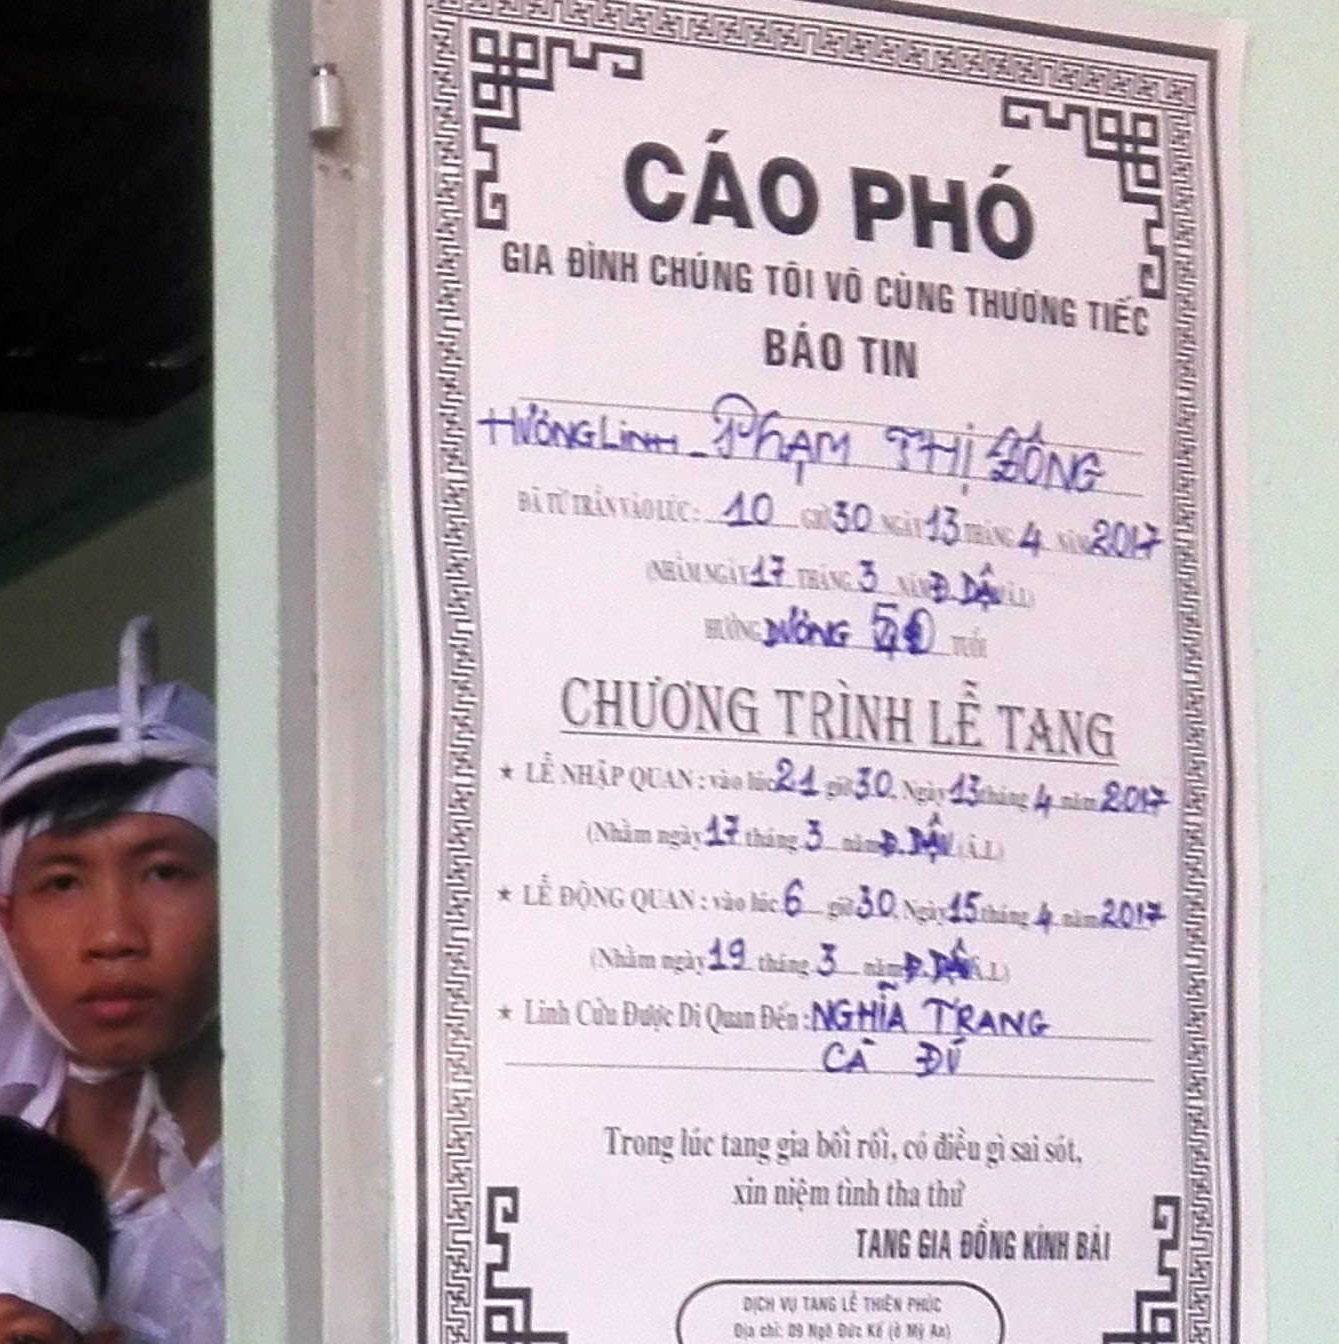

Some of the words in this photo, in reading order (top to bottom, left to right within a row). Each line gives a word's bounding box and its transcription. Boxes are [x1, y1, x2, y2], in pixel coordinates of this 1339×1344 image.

[623, 127, 820, 237] CÁO
[850, 164, 1034, 260] PHÓ
[501, 241, 553, 276] GIA
[567, 241, 638, 283] ĐÌNH
[649, 251, 753, 294] CHÚNG
[765, 261, 814, 299] TÔI
[825, 267, 862, 304] VÔ
[875, 271, 953, 313] CÙNG
[964, 285, 1076, 328] THƯƠNG
[1086, 295, 1149, 337] TIẾC
[764, 321, 842, 372] BÁO
[858, 336, 918, 378] TIN
[723, 490, 773, 527] 10
[833, 499, 872, 534] 30
[925, 504, 962, 546] 13
[1018, 520, 1042, 557] 4
[1092, 518, 1163, 559] 2017
[749, 554, 786, 587] 17
[858, 559, 879, 593] 3
[560, 675, 759, 735] CHƯƠNG
[774, 678, 913, 744] TRÌNH
[930, 679, 983, 748] LỄ
[997, 702, 1116, 757] TANG
[525, 751, 555, 785] LỄ
[562, 759, 624, 790] NHẬP
[629, 765, 694, 793] QUAN
[774, 756, 819, 797] 21
[854, 766, 893, 800] 30
[949, 772, 983, 806] 13
[1034, 783, 1052, 817] 4
[1099, 779, 1169, 817] 2017
[706, 814, 739, 846] 17
[805, 818, 822, 852] 3
[522, 874, 554, 906] LỄ
[559, 880, 624, 911] ĐỘNG
[630, 887, 694, 914] QUAN
[783, 877, 805, 918] 6
[855, 883, 896, 919] 30
[948, 891, 983, 924] 15
[1034, 901, 1054, 934] 4
[1101, 896, 1167, 931] 2017
[708, 936, 747, 972] 19
[817, 942, 837, 977] 3
[524, 998, 571, 1027] Linh
[622, 999, 673, 1033] Được
[679, 1001, 702, 1028] Di
[705, 1002, 756, 1035] Quan
[923, 996, 1050, 1037] TRANG
[604, 1125, 674, 1164] Trong
[680, 1127, 714, 1157] lúc
[721, 1132, 772, 1166] tang
[776, 1129, 809, 1166] gia
[903, 1130, 928, 1161] có
[934, 1126, 981, 1161] điều
[985, 1133, 1006, 1170] gì
[1010, 1134, 1039, 1163] sai
[732, 1176, 768, 1206] xin
[774, 1177, 830, 1212] niệm
[837, 1177, 881, 1207] tình
[886, 1178, 920, 1208] tha
[856, 1227, 911, 1259] TANG
[917, 1228, 952, 1260] GIA
[959, 1217, 1017, 1260] ĐỒNG
[1023, 1223, 1070, 1261] KÍNH
[802, 1295, 837, 1312] TANG
